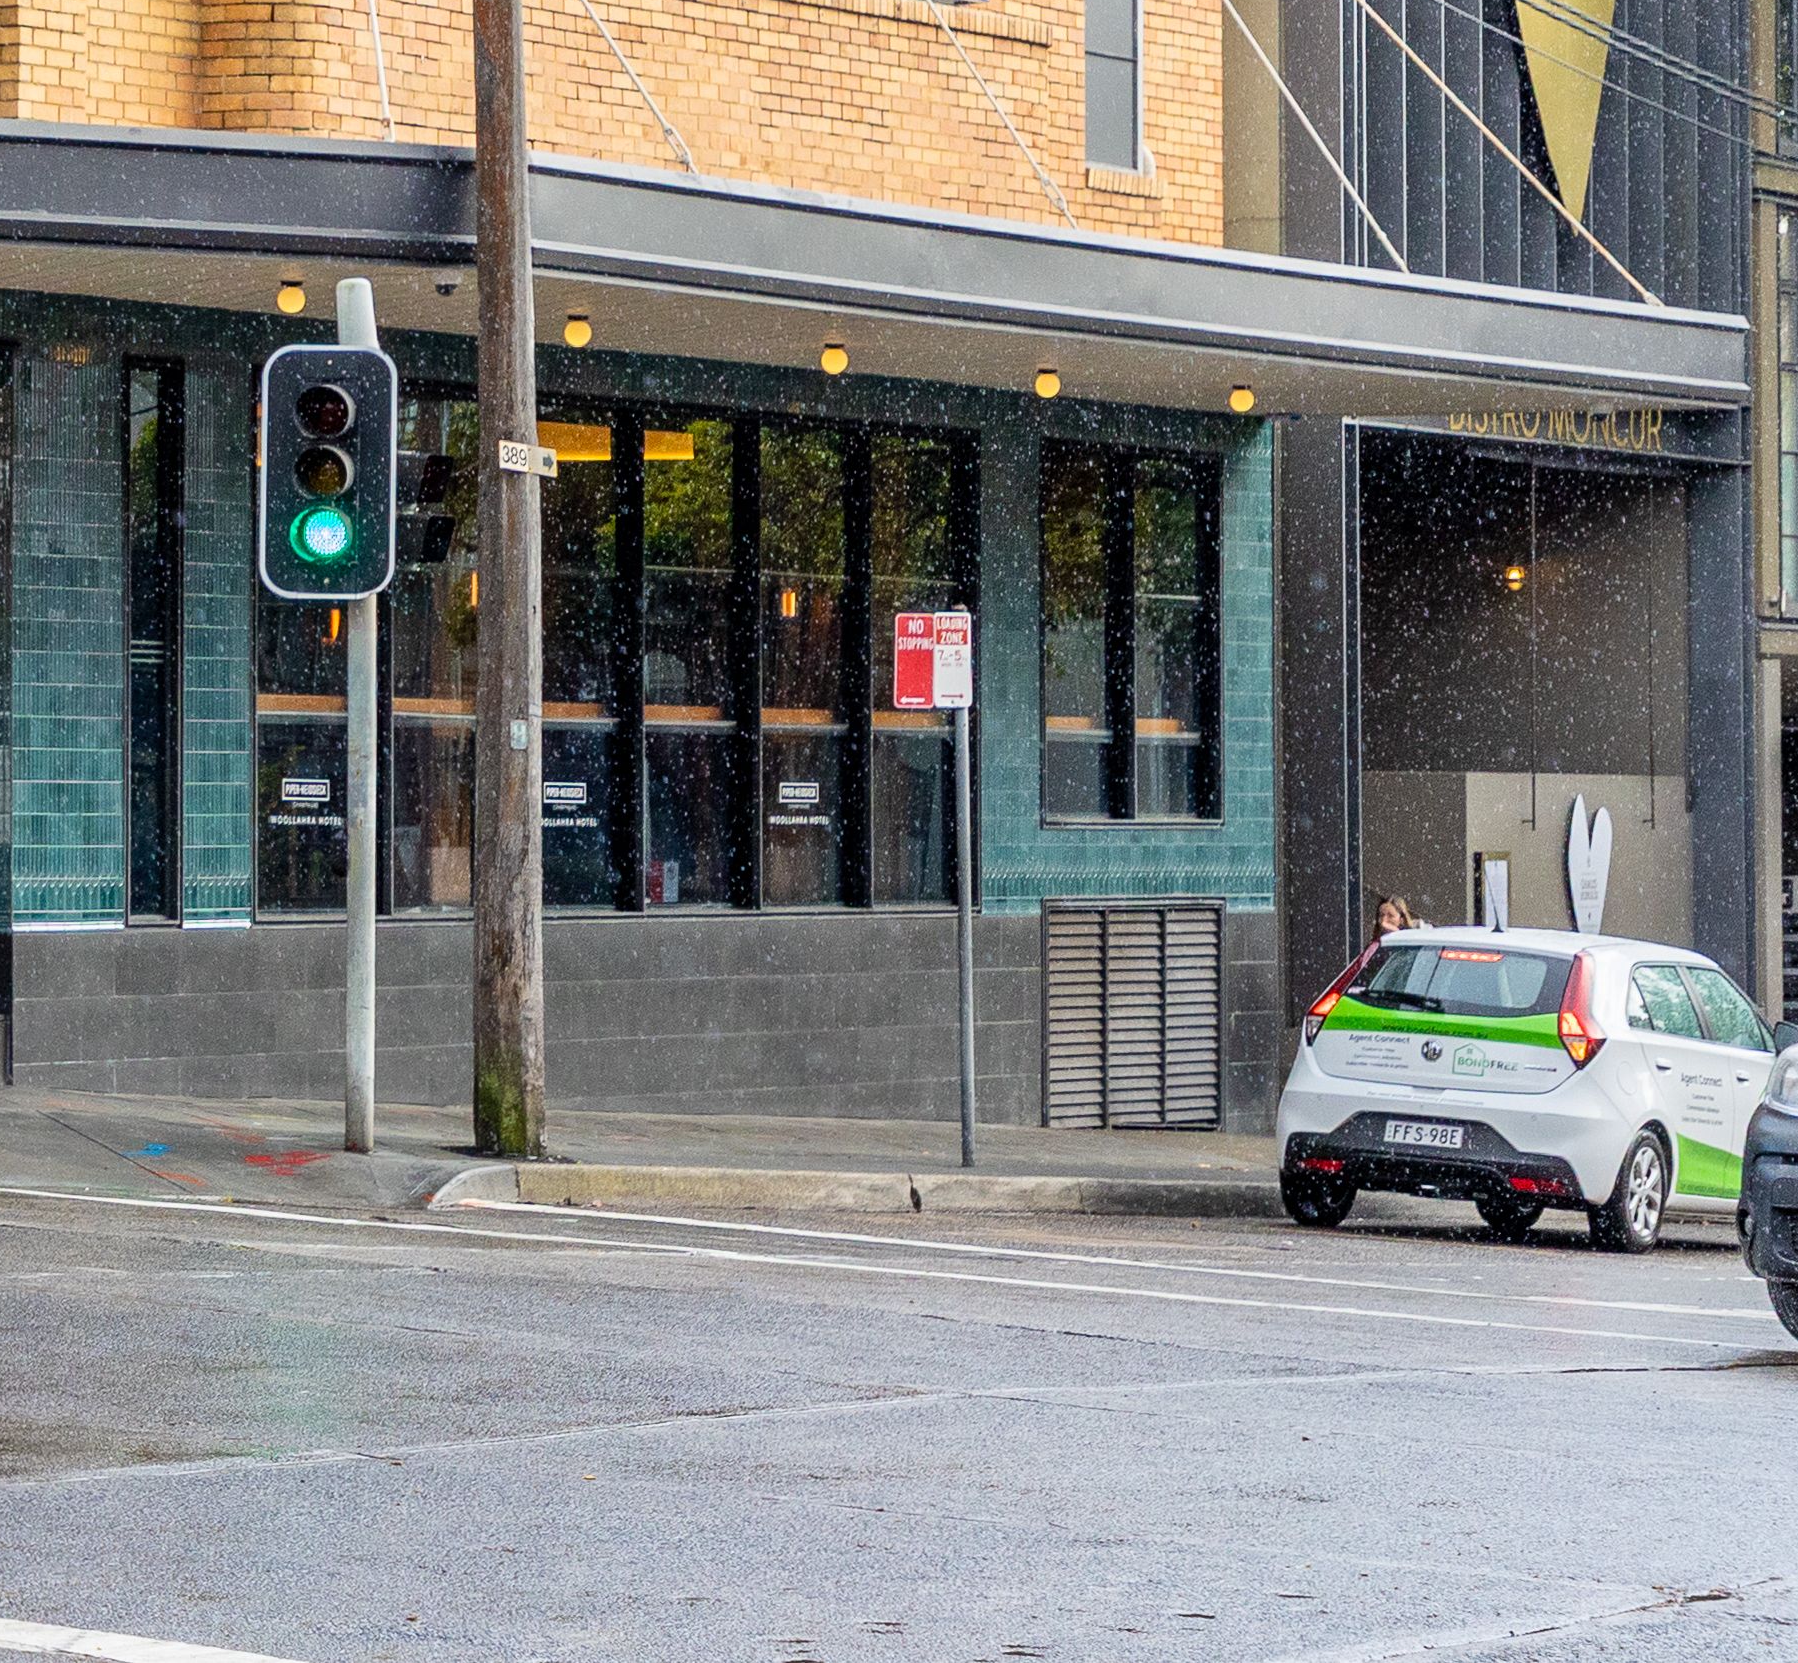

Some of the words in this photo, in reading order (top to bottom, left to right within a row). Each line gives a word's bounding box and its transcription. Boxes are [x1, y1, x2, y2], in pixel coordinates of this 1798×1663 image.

[502, 444, 527, 466] 389
[908, 619, 924, 635] NO
[936, 617, 968, 630] LOADING
[898, 637, 934, 651] STOPPING
[940, 631, 965, 644] ZONE
[1457, 1055, 1519, 1072] BONDFREE
